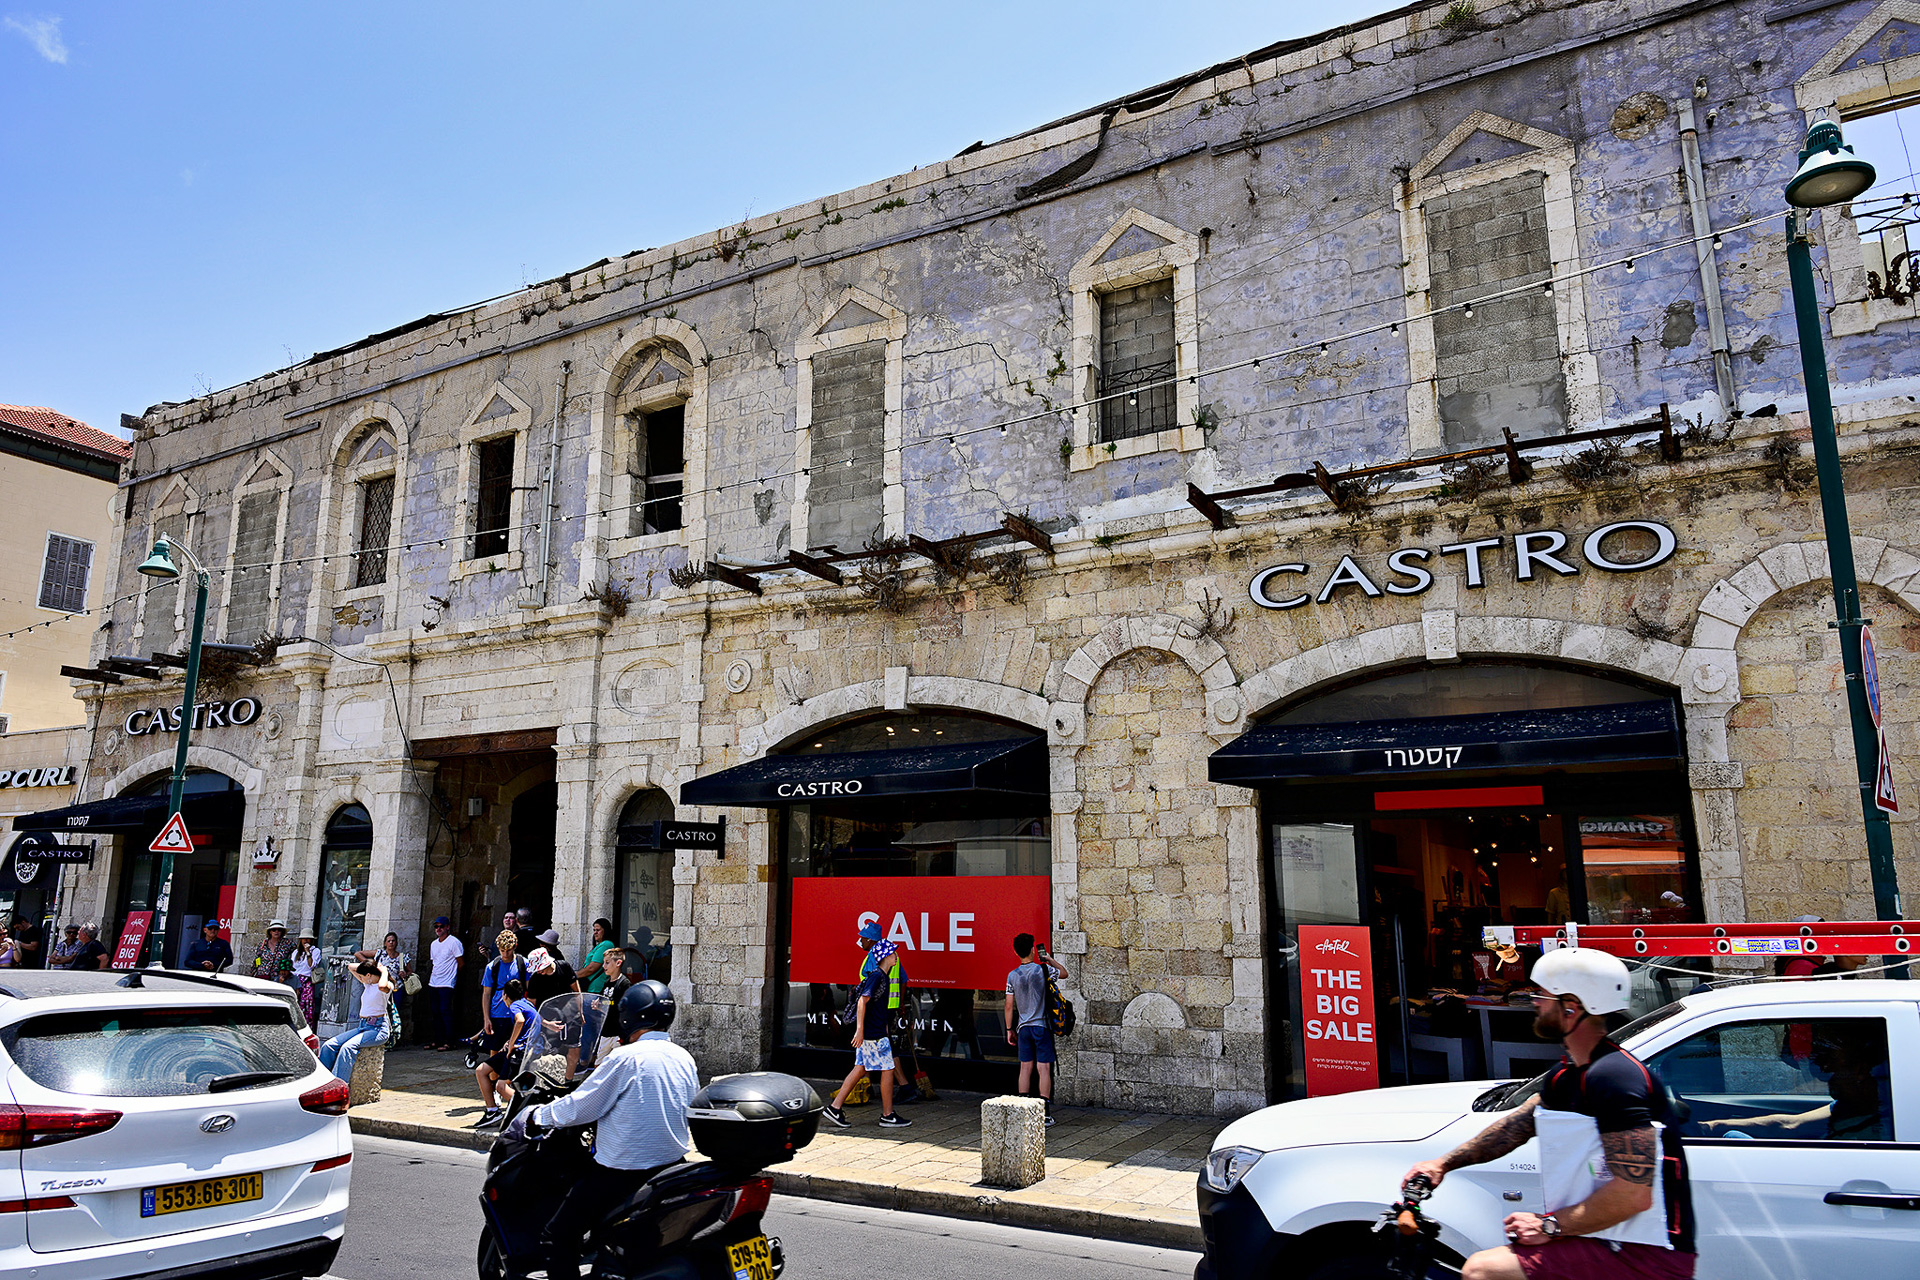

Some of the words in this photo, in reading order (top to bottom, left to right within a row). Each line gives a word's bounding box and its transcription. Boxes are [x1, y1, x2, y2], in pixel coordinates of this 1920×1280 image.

[1249, 520, 1676, 609] CASTRO
[124, 697, 257, 735] CASTRO
[1385, 746, 1463, 769] קסטרו
[12, 766, 70, 788] CURL
[777, 780, 863, 797] CASTRO
[67, 816, 90, 827] קסטרו
[666, 830, 716, 842] CASTRO
[28, 849, 84, 859] CASTRO
[123, 934, 142, 945] THE
[119, 948, 136, 959] BIG
[1310, 968, 1362, 990] THE
[1316, 994, 1359, 1016] BIG
[898, 1018, 953, 1032] OMEN
[1306, 1019, 1373, 1043] SALE
[1510, 1163, 1536, 1171] 514024
